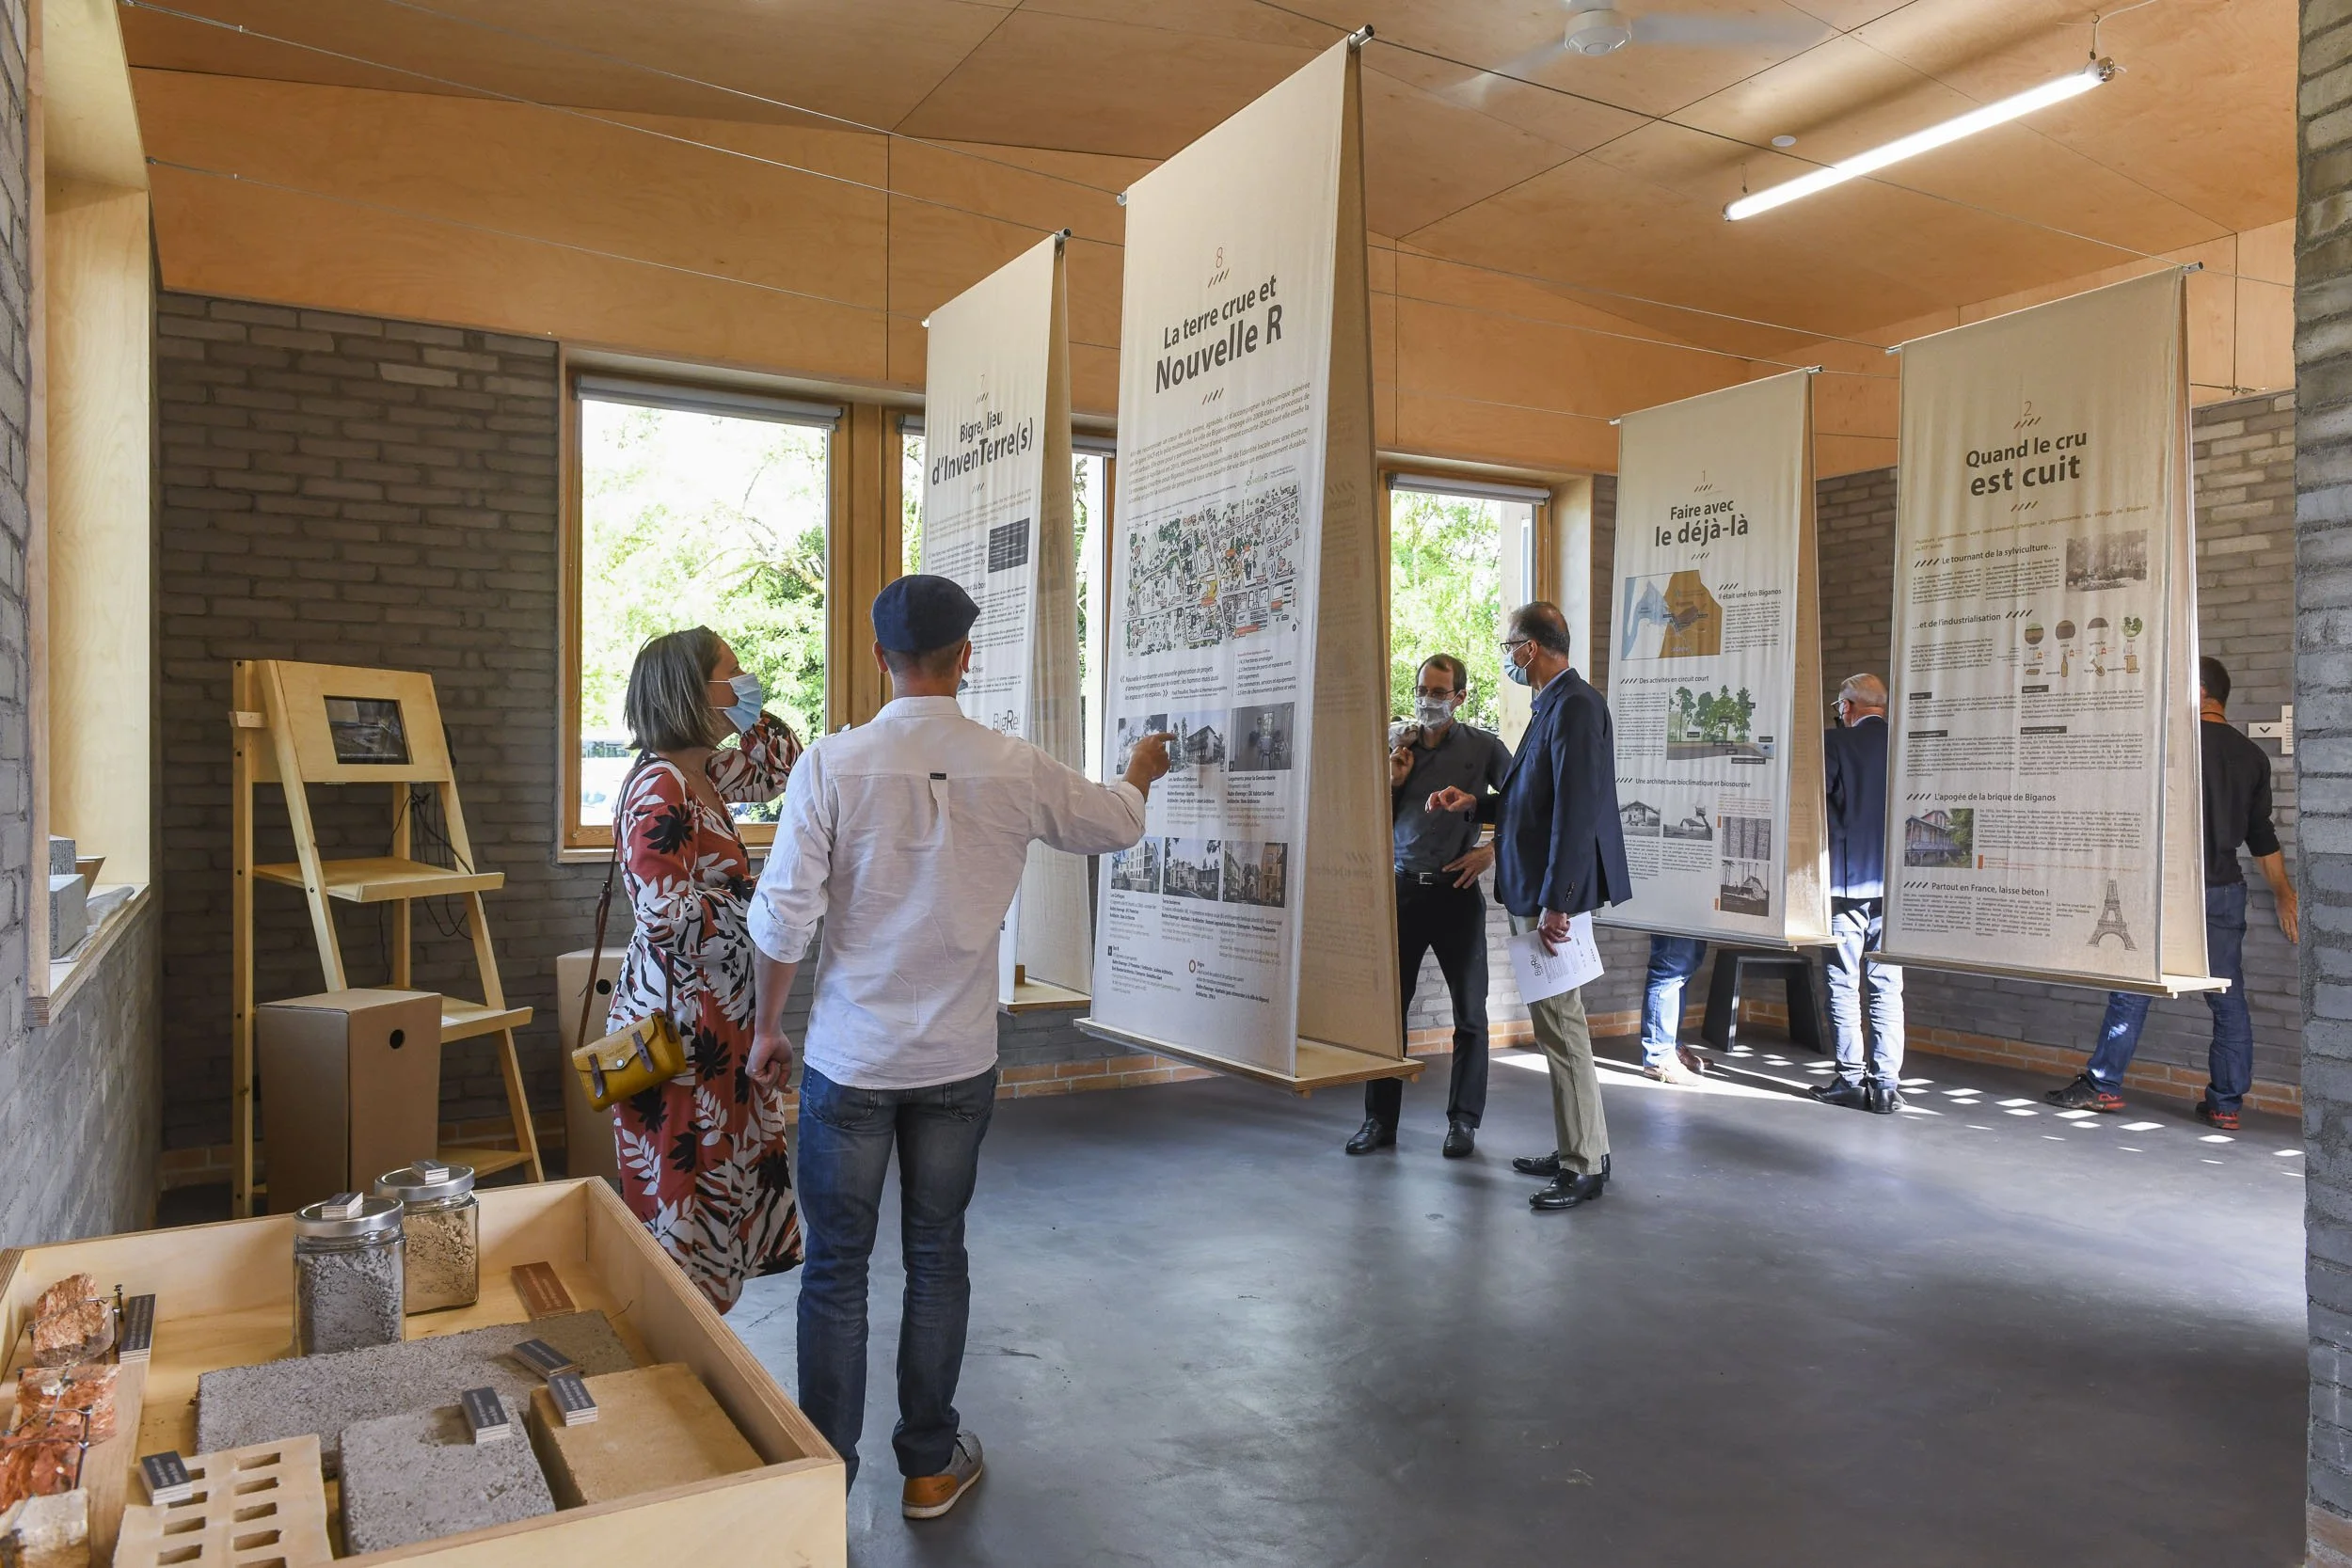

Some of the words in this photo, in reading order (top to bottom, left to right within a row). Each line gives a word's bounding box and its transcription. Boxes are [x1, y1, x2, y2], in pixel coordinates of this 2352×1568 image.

[1216, 245, 1222, 268] 8
[1164, 327, 1180, 349] La
[1183, 309, 1218, 340] terre
[1221, 290, 1255, 320] crue
[1259, 275, 1276, 302] et
[1155, 319, 1259, 393] Nouvelle
[1266, 301, 1282, 345] R
[2024, 400, 2031, 416] 2
[960, 421, 983, 444] Bigre,
[986, 411, 1002, 431] lieu
[1965, 439, 2027, 468] Quand
[2034, 436, 2050, 454] le
[2056, 433, 2086, 450] cru
[1970, 467, 2012, 496] est
[2022, 455, 2080, 487] cuit
[1670, 504, 1701, 520] Faire
[1704, 500, 1733, 515] avec
[1655, 526, 1671, 546] le
[1677, 514, 1748, 546] déjà-là
[1951, 552, 1983, 562] tournant
[1934, 793, 1966, 801] L'apogée
[1987, 793, 2010, 801] brique
[2025, 793, 2056, 802] Biganos
[1931, 882, 1958, 891] Partout
[1971, 884, 1996, 894] France,
[1998, 885, 2019, 894] laisse
[2021, 887, 2044, 895] béton
